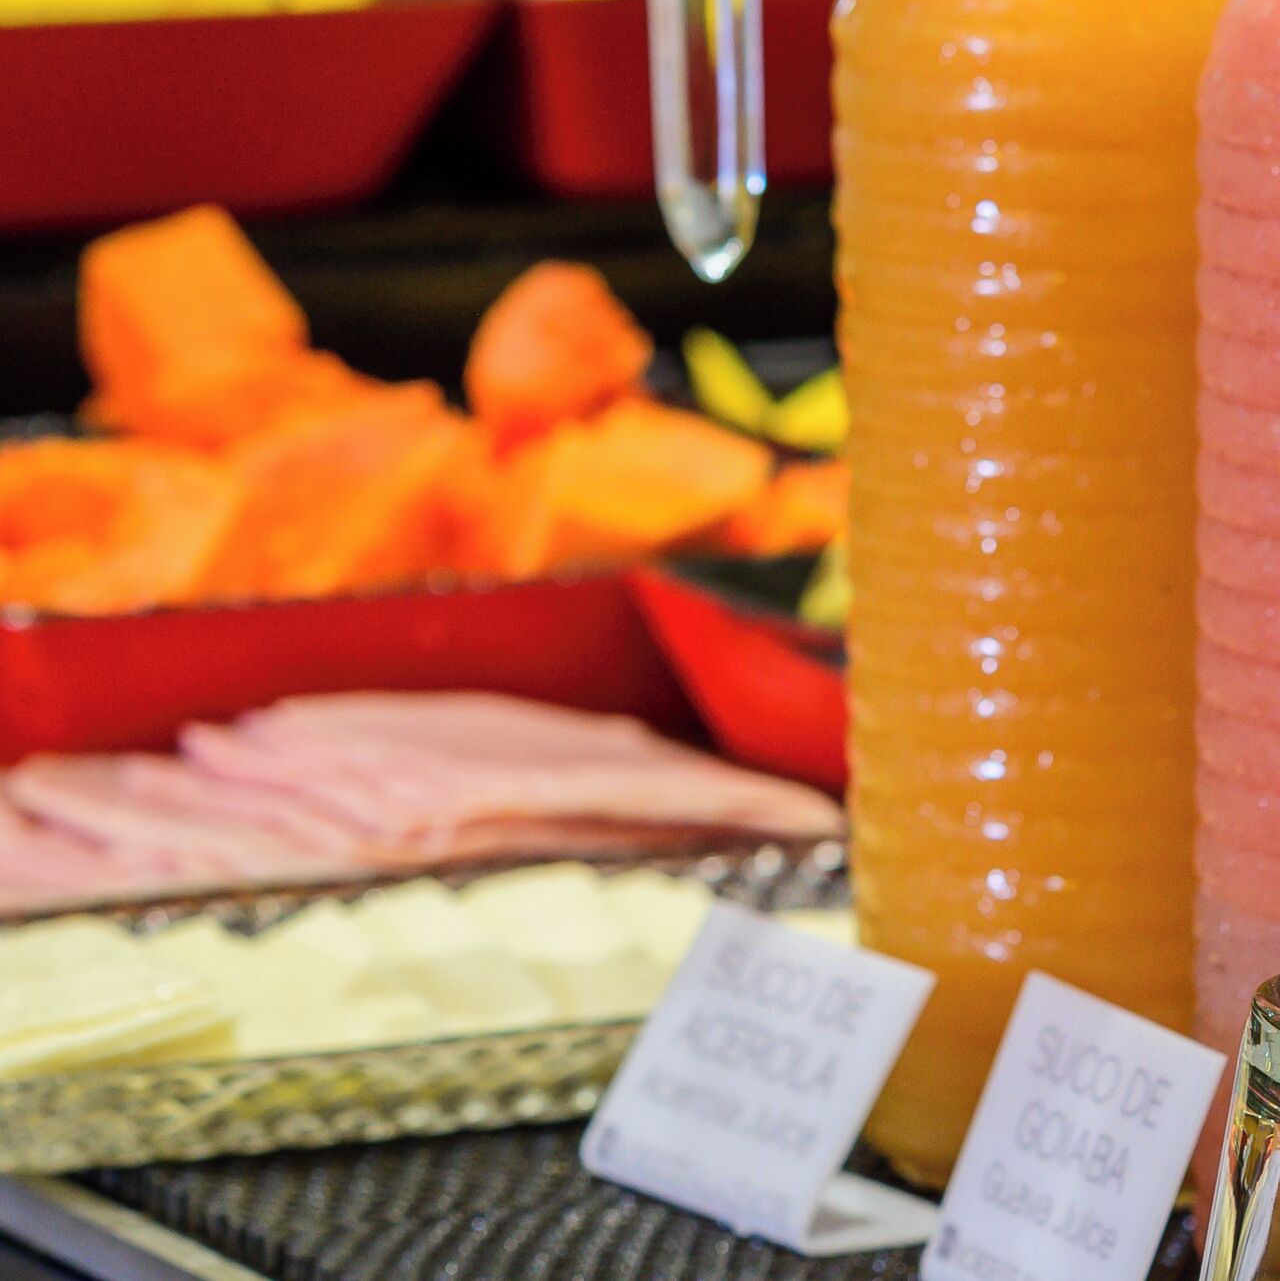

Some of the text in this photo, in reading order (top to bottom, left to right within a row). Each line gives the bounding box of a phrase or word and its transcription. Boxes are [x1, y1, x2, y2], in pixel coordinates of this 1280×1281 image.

[702, 937, 877, 1038] SUCO DE
[670, 1006, 841, 1100] ACEROLA
[1026, 1021, 1174, 1132] SUCO DE
[979, 1158, 1055, 1230] Guava
[1012, 1097, 1133, 1197] GOIABA
